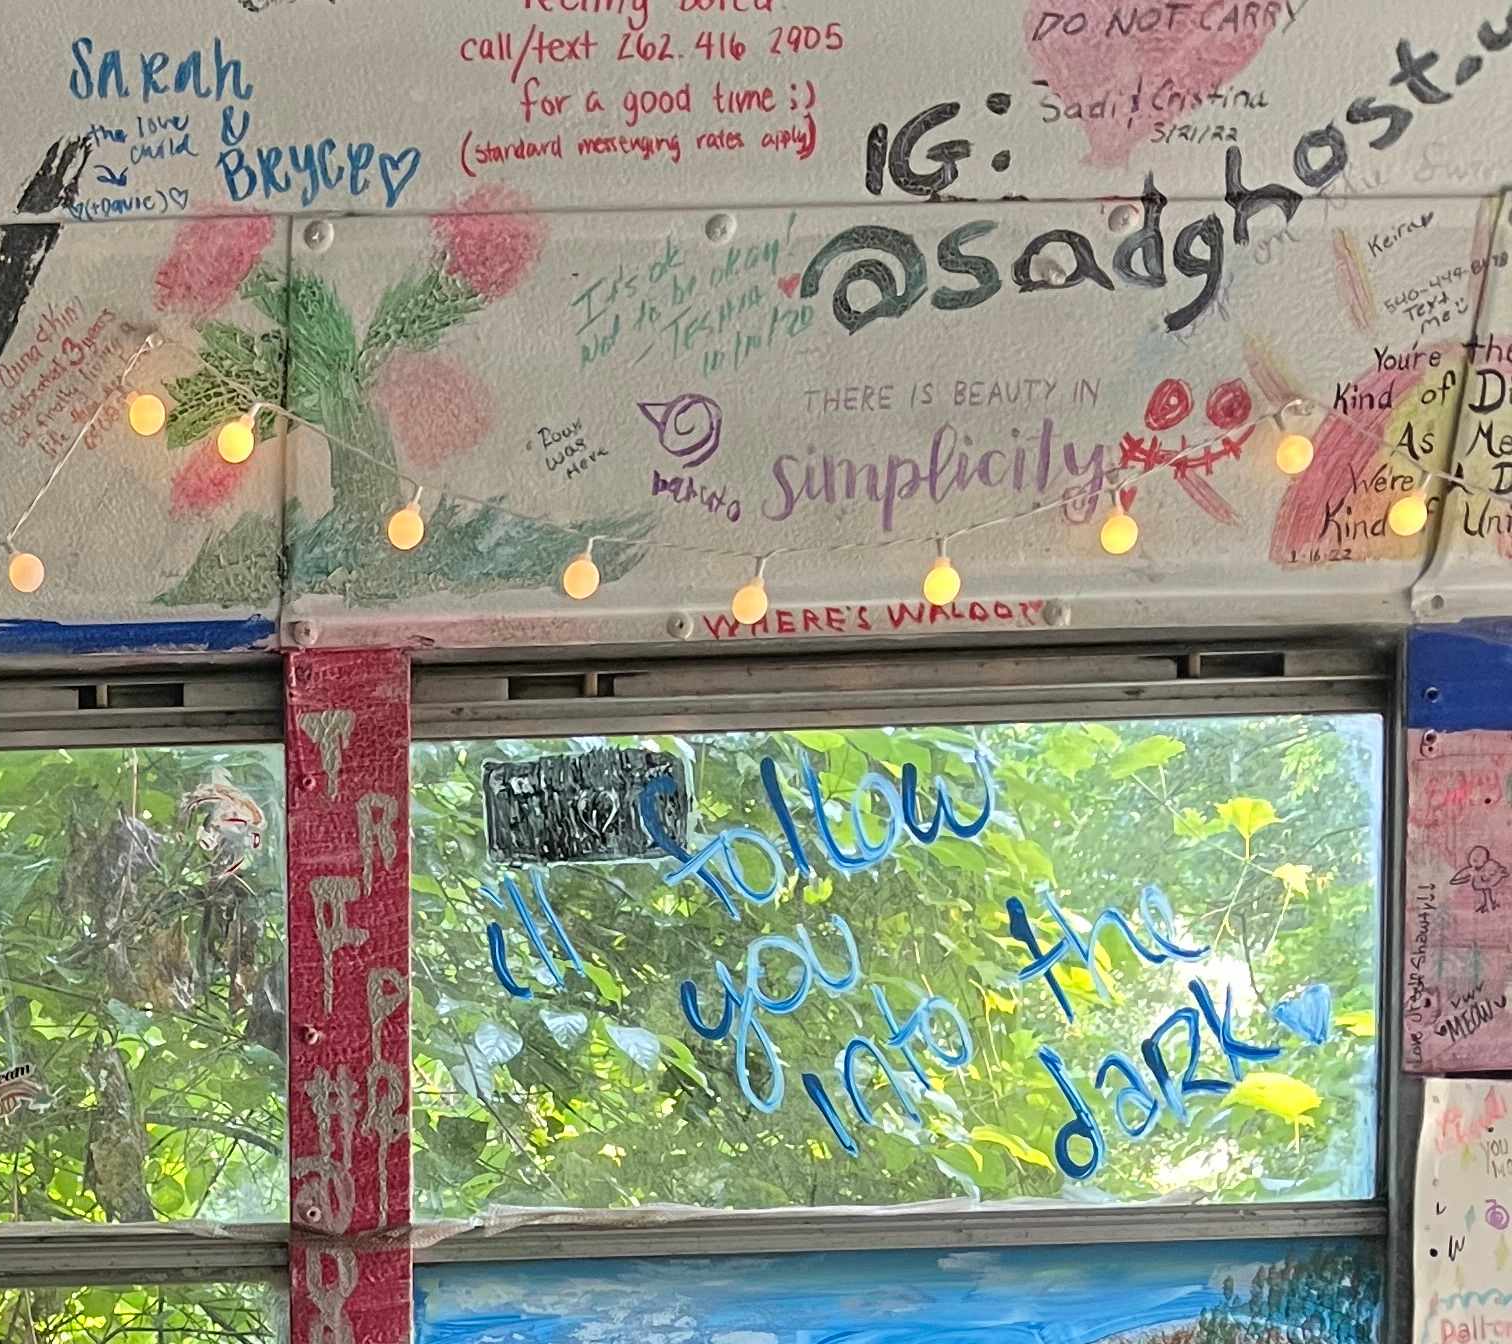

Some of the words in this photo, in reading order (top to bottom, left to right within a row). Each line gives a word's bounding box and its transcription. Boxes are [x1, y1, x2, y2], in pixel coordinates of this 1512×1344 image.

[1032, 12, 1087, 41] DO
[1105, 3, 1194, 38] NOT
[460, 24, 597, 83] call/text
[696, 32, 746, 61] 416
[519, 77, 569, 122] for
[586, 94, 605, 112] a
[624, 84, 690, 127] good
[712, 82, 776, 113] time
[697, 130, 745, 150] rates
[804, 385, 894, 413] THERE
[911, 383, 934, 405] IS
[954, 379, 1057, 406] BEAUTY
[1074, 377, 1103, 408] IN
[1333, 379, 1394, 415] Kind
[1420, 370, 1456, 405] of
[1389, 421, 1436, 462] As
[761, 417, 1106, 531] simplicity
[1319, 497, 1389, 545] Kind
[680, 913, 864, 1115] you
[1007, 881, 1211, 1023] the
